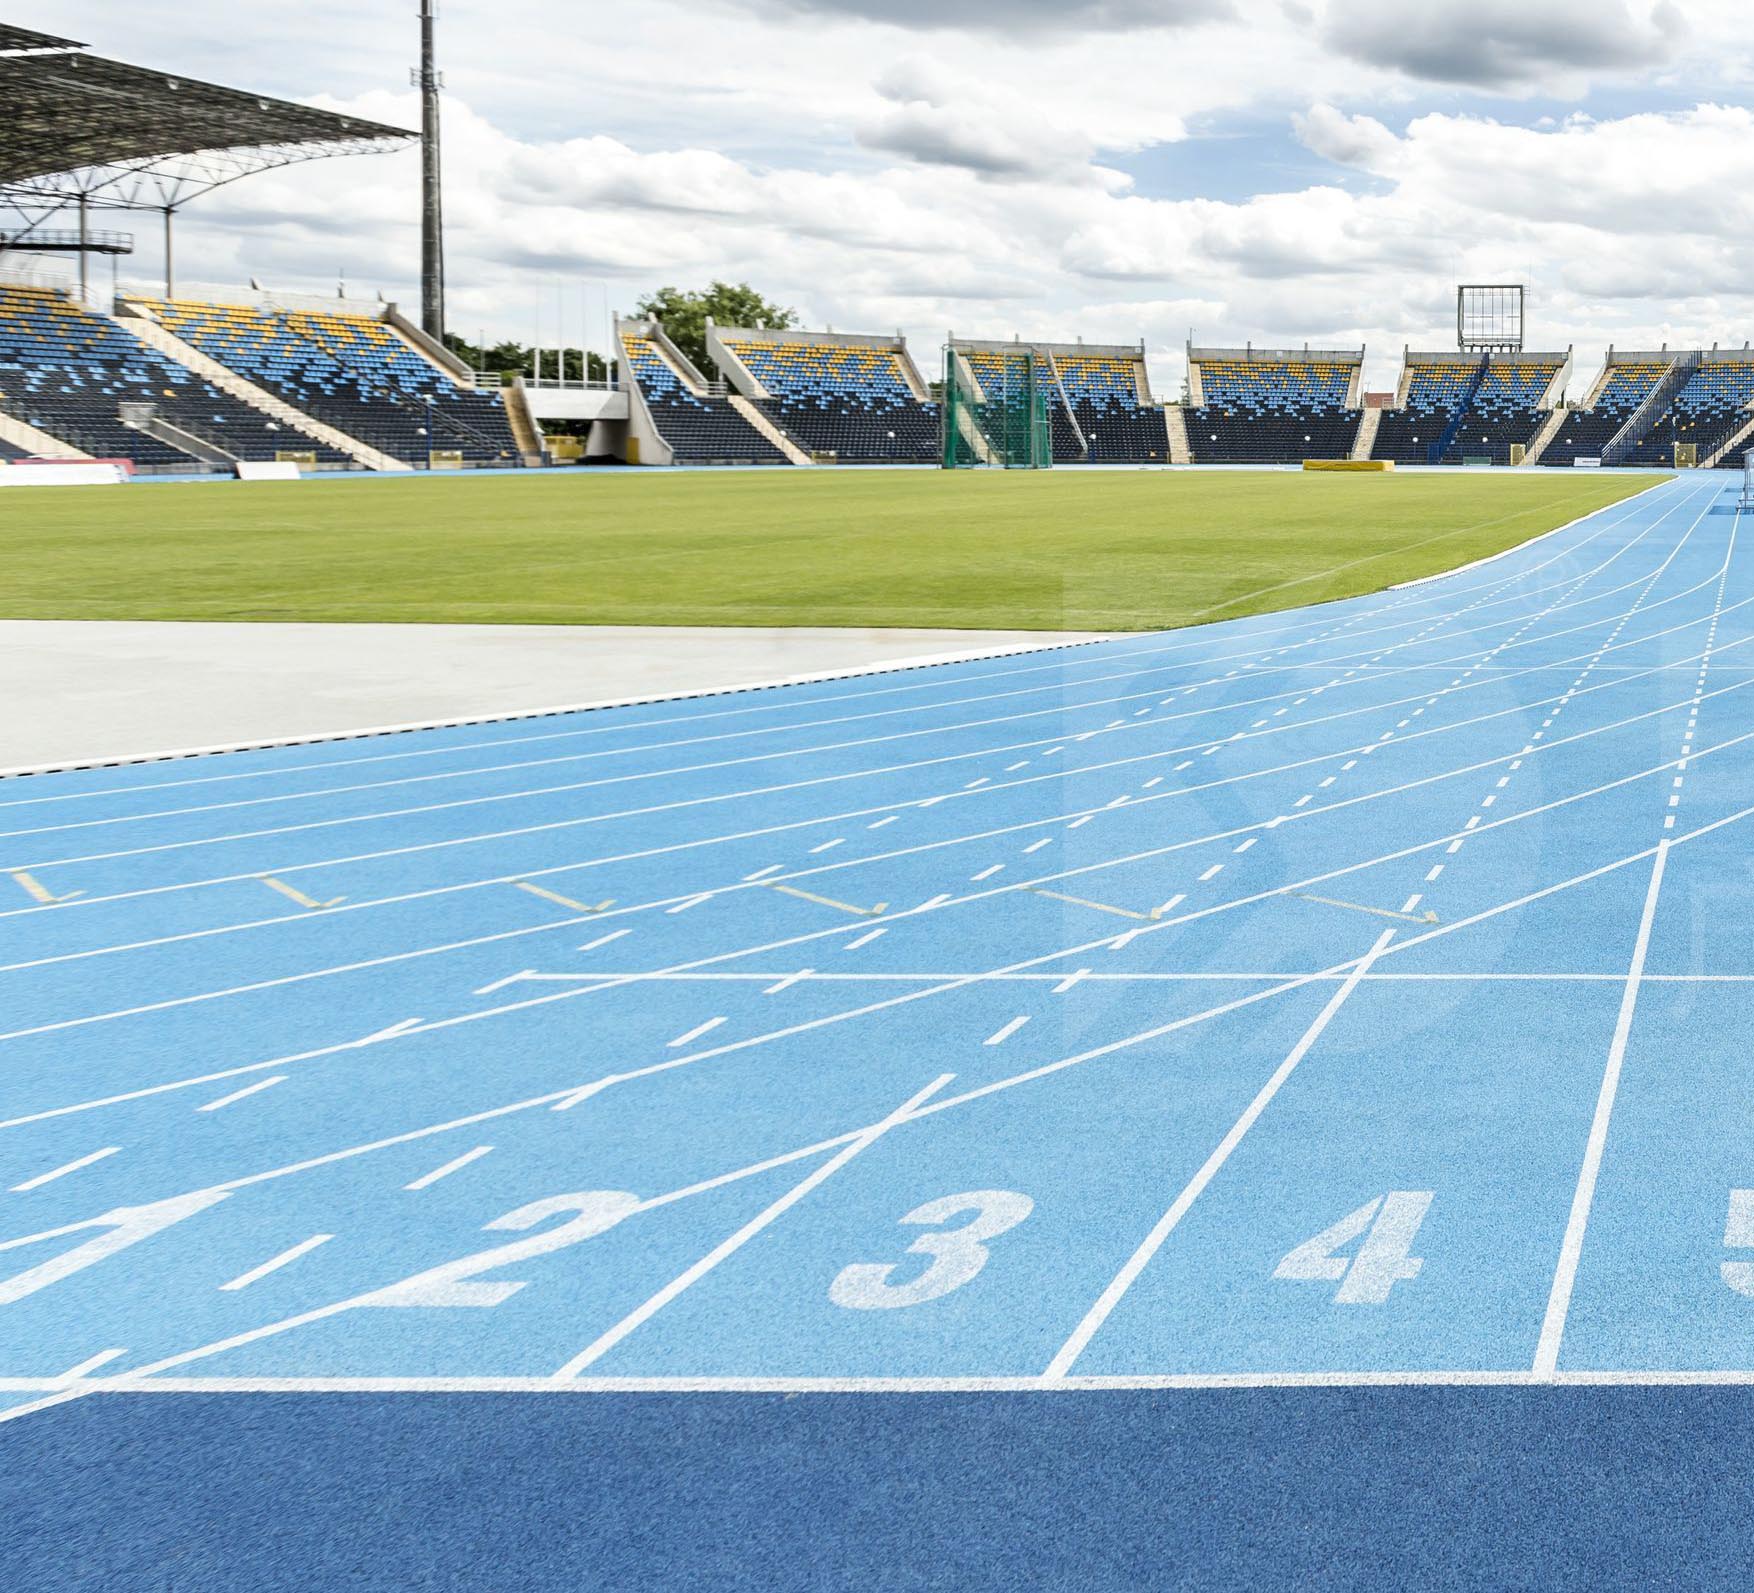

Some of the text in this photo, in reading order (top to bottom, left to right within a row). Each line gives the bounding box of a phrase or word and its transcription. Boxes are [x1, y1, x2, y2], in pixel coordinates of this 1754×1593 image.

[0, 1190, 232, 1304] 1
[358, 1190, 640, 1307] 2
[828, 1189, 1035, 1310] 3
[1271, 1190, 1435, 1303] 4
